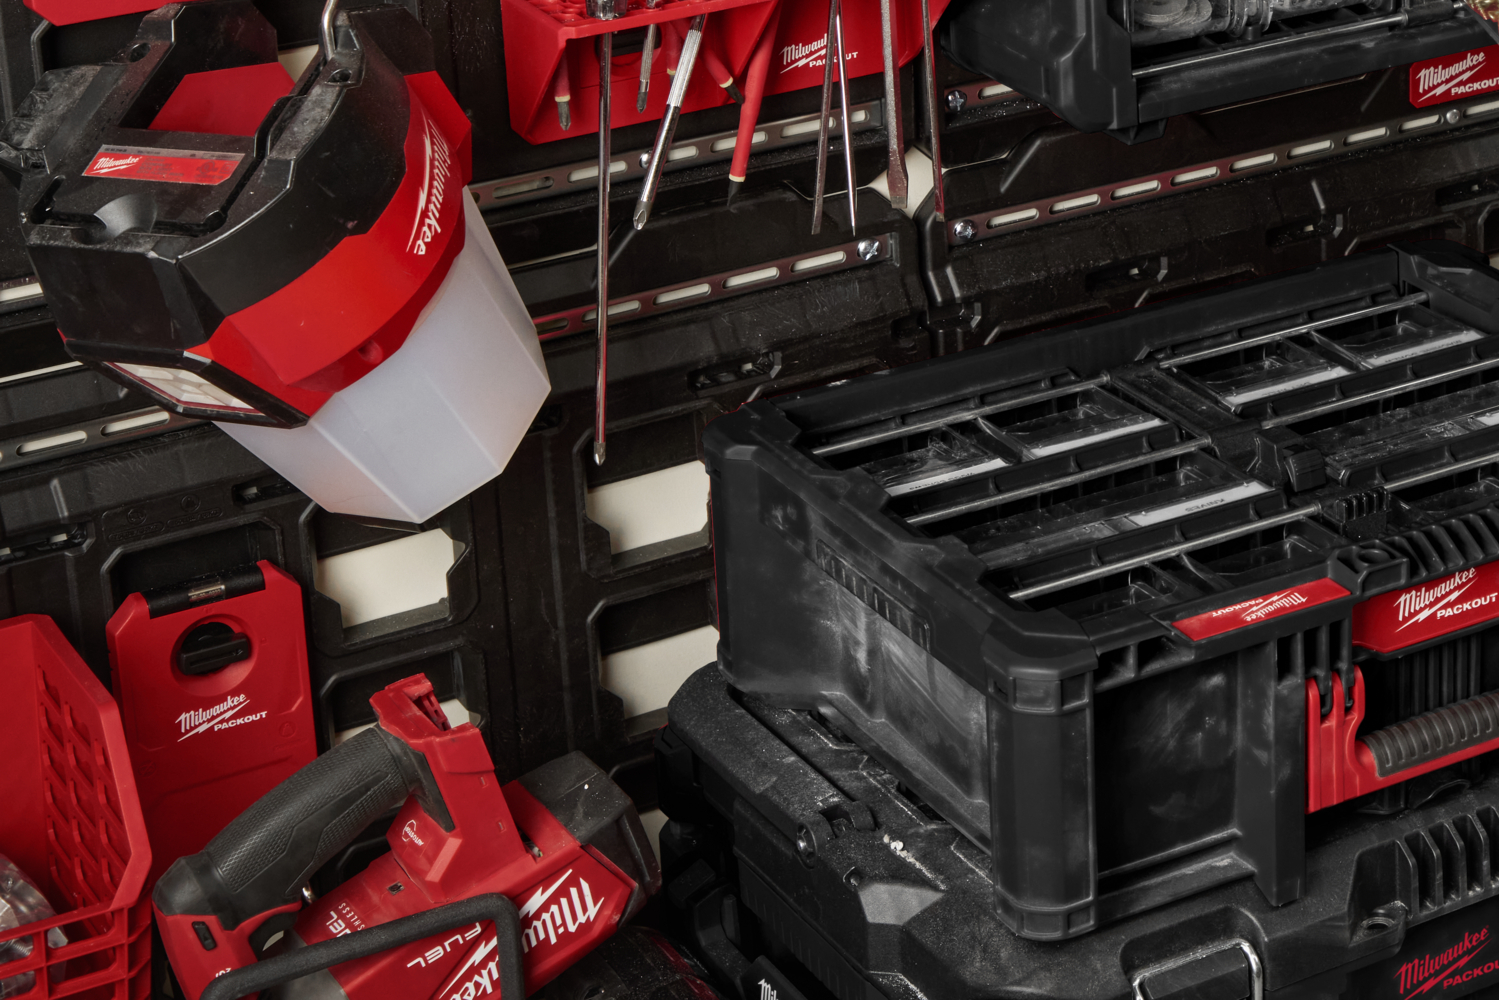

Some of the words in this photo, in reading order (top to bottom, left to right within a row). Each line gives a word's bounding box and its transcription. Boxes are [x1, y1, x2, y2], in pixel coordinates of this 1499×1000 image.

[1415, 51, 1487, 93] Milwaukee
[413, 118, 452, 256] Milwaukee
[1185, 498, 1225, 512] KNIVES
[1212, 598, 1264, 618] PACKOUT
[1243, 592, 1308, 622] Milwaukee
[1393, 567, 1478, 622] Milwaukee
[1436, 592, 1499, 621] PACKOUT
[175, 694, 247, 733] Milwaukee
[214, 711, 268, 732] PACKOUT
[407, 922, 483, 968] FUEL
[1399, 926, 1490, 993] Milwaukee
